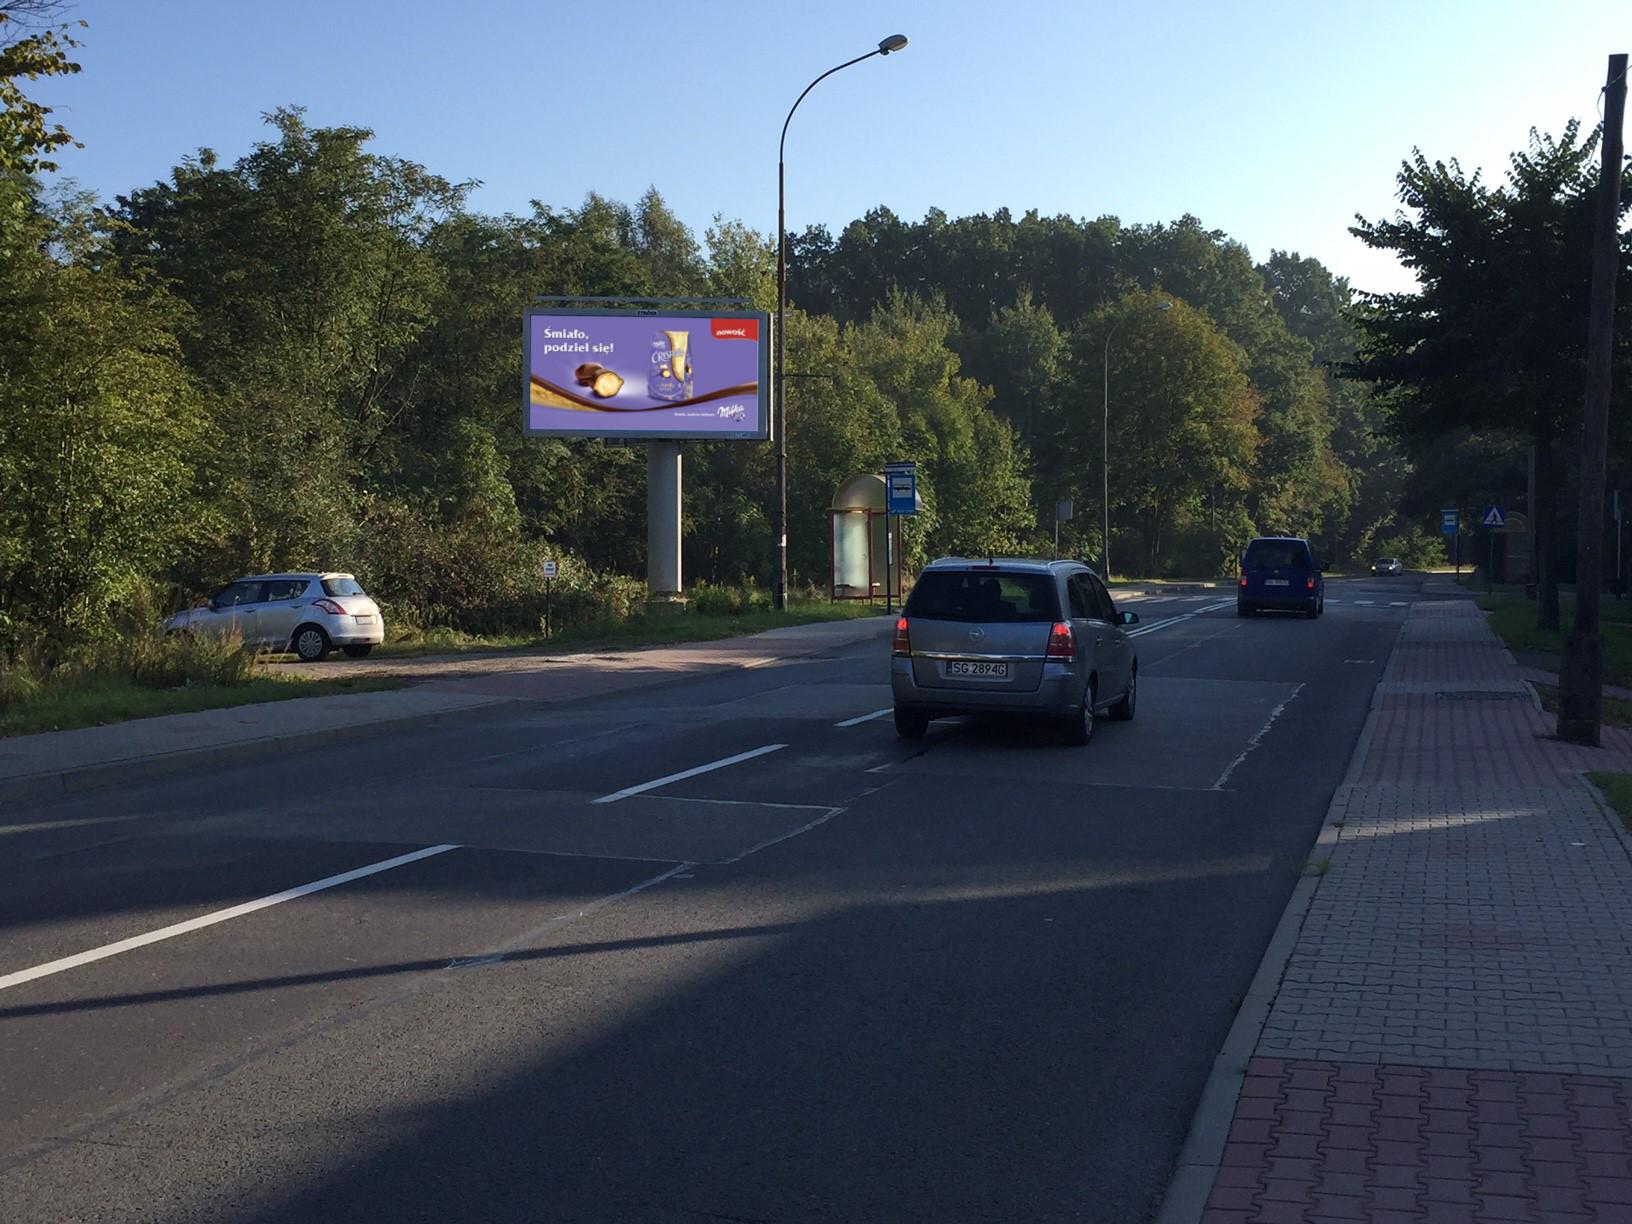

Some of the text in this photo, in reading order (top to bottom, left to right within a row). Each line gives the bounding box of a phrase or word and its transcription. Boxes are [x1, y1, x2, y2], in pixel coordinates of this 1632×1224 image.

[544, 342, 614, 355] podziel się!
[717, 404, 745, 418] Milka
[953, 662, 1005, 675] SG 2894G
